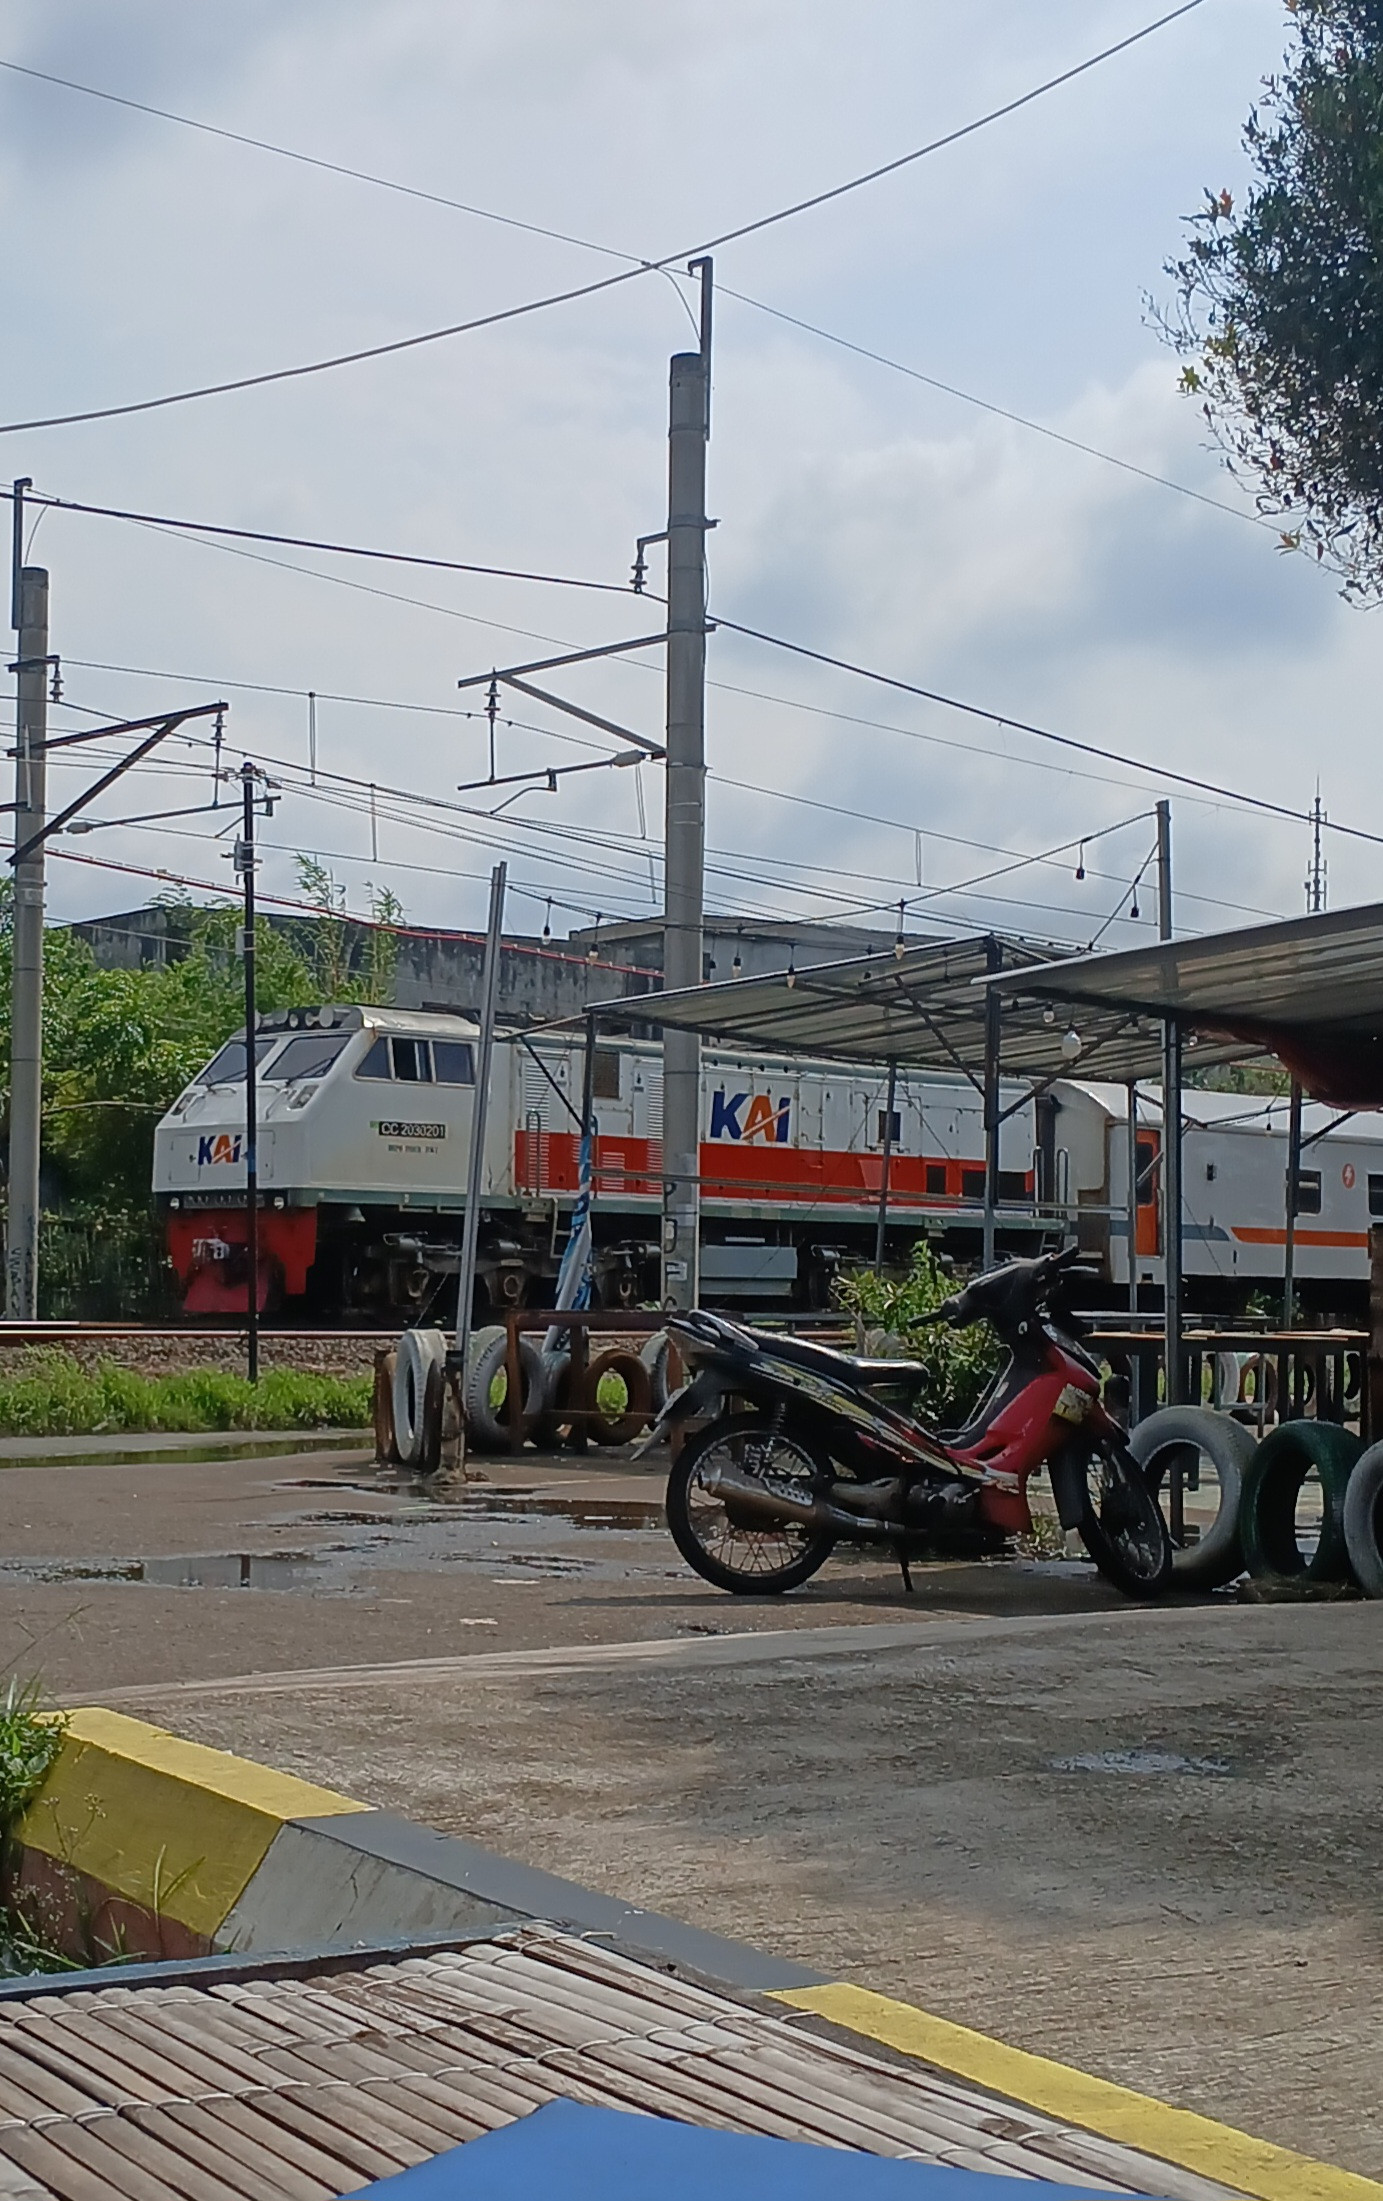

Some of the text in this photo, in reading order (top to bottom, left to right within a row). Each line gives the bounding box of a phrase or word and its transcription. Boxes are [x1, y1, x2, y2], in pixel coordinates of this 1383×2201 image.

[381, 1122, 444, 1137] CC 2030201
[710, 1091, 791, 1143] KAI
[197, 1134, 243, 1166] KAI
